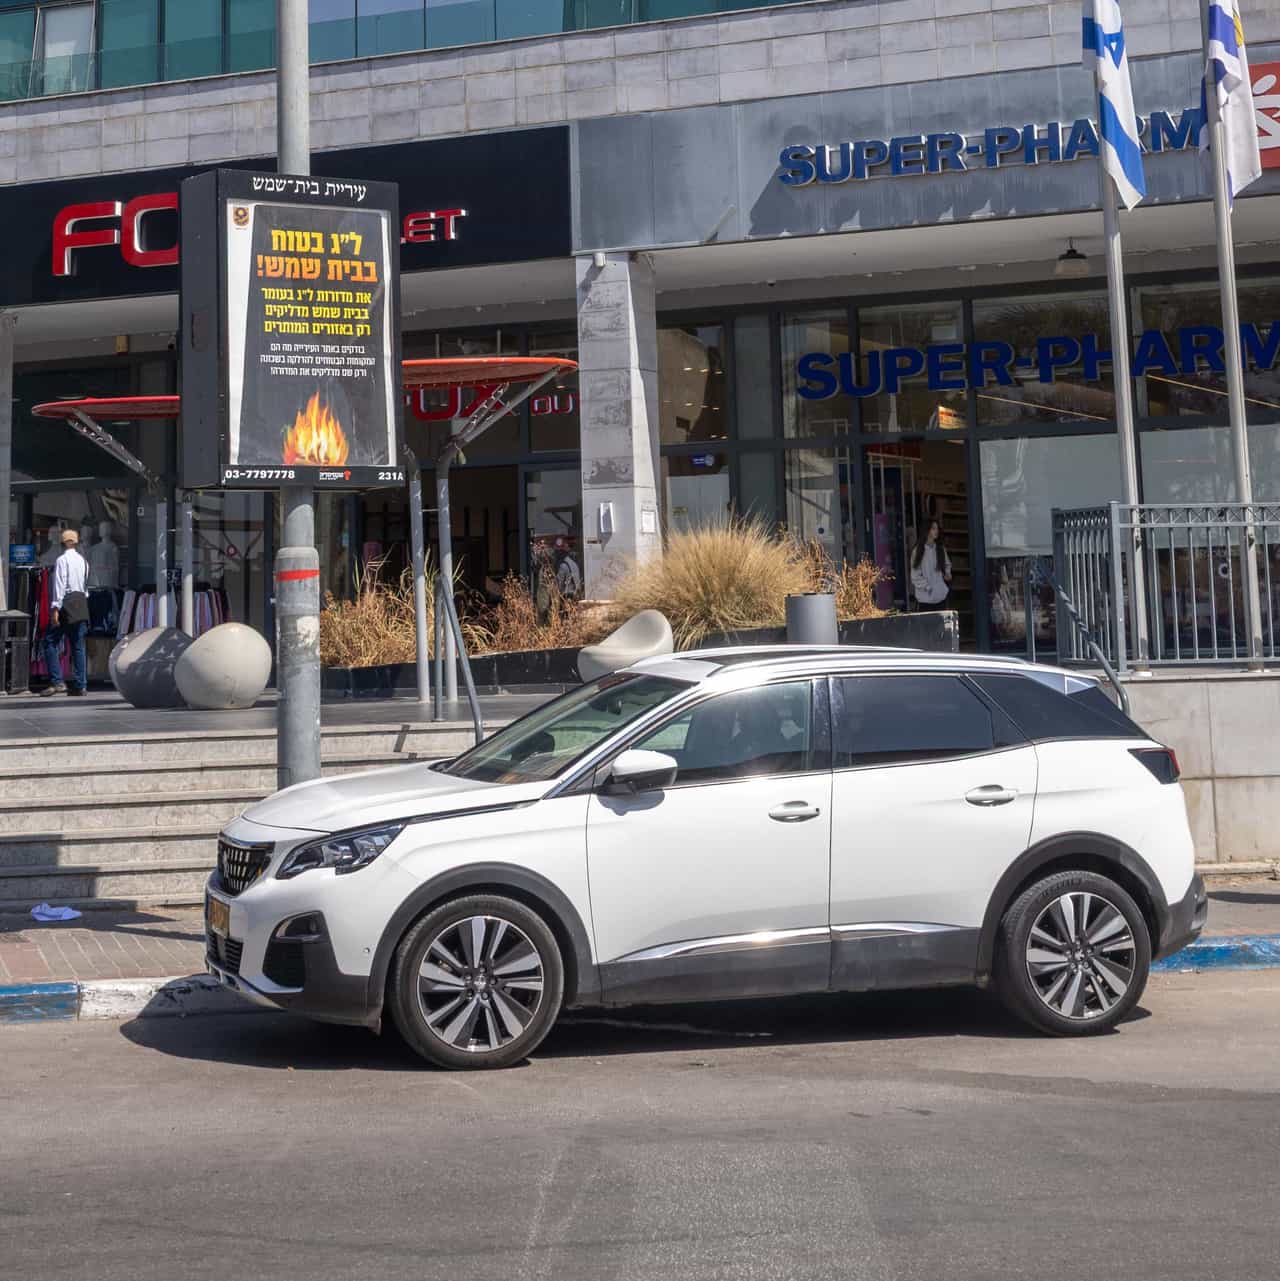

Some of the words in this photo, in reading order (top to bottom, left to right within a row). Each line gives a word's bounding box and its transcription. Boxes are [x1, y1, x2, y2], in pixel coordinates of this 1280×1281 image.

[778, 107, 1205, 186] SUPER-PHAM
[325, 182, 367, 201] עיריית
[272, 230, 324, 253] בטוח
[257, 255, 320, 279] שמש!
[327, 259, 378, 282] בבית
[261, 288, 294, 300] בעומר
[317, 290, 352, 302] מדורות
[356, 292, 371, 304] את
[265, 304, 309, 318] מדליקים
[312, 306, 340, 319] שמש
[344, 308, 369, 319] בבית
[264, 321, 309, 333] המותרים
[312, 323, 353, 335] באזורים
[356, 324, 371, 336] רק
[225, 470, 295, 480] 03-7797778
[378, 472, 404, 481] 231A
